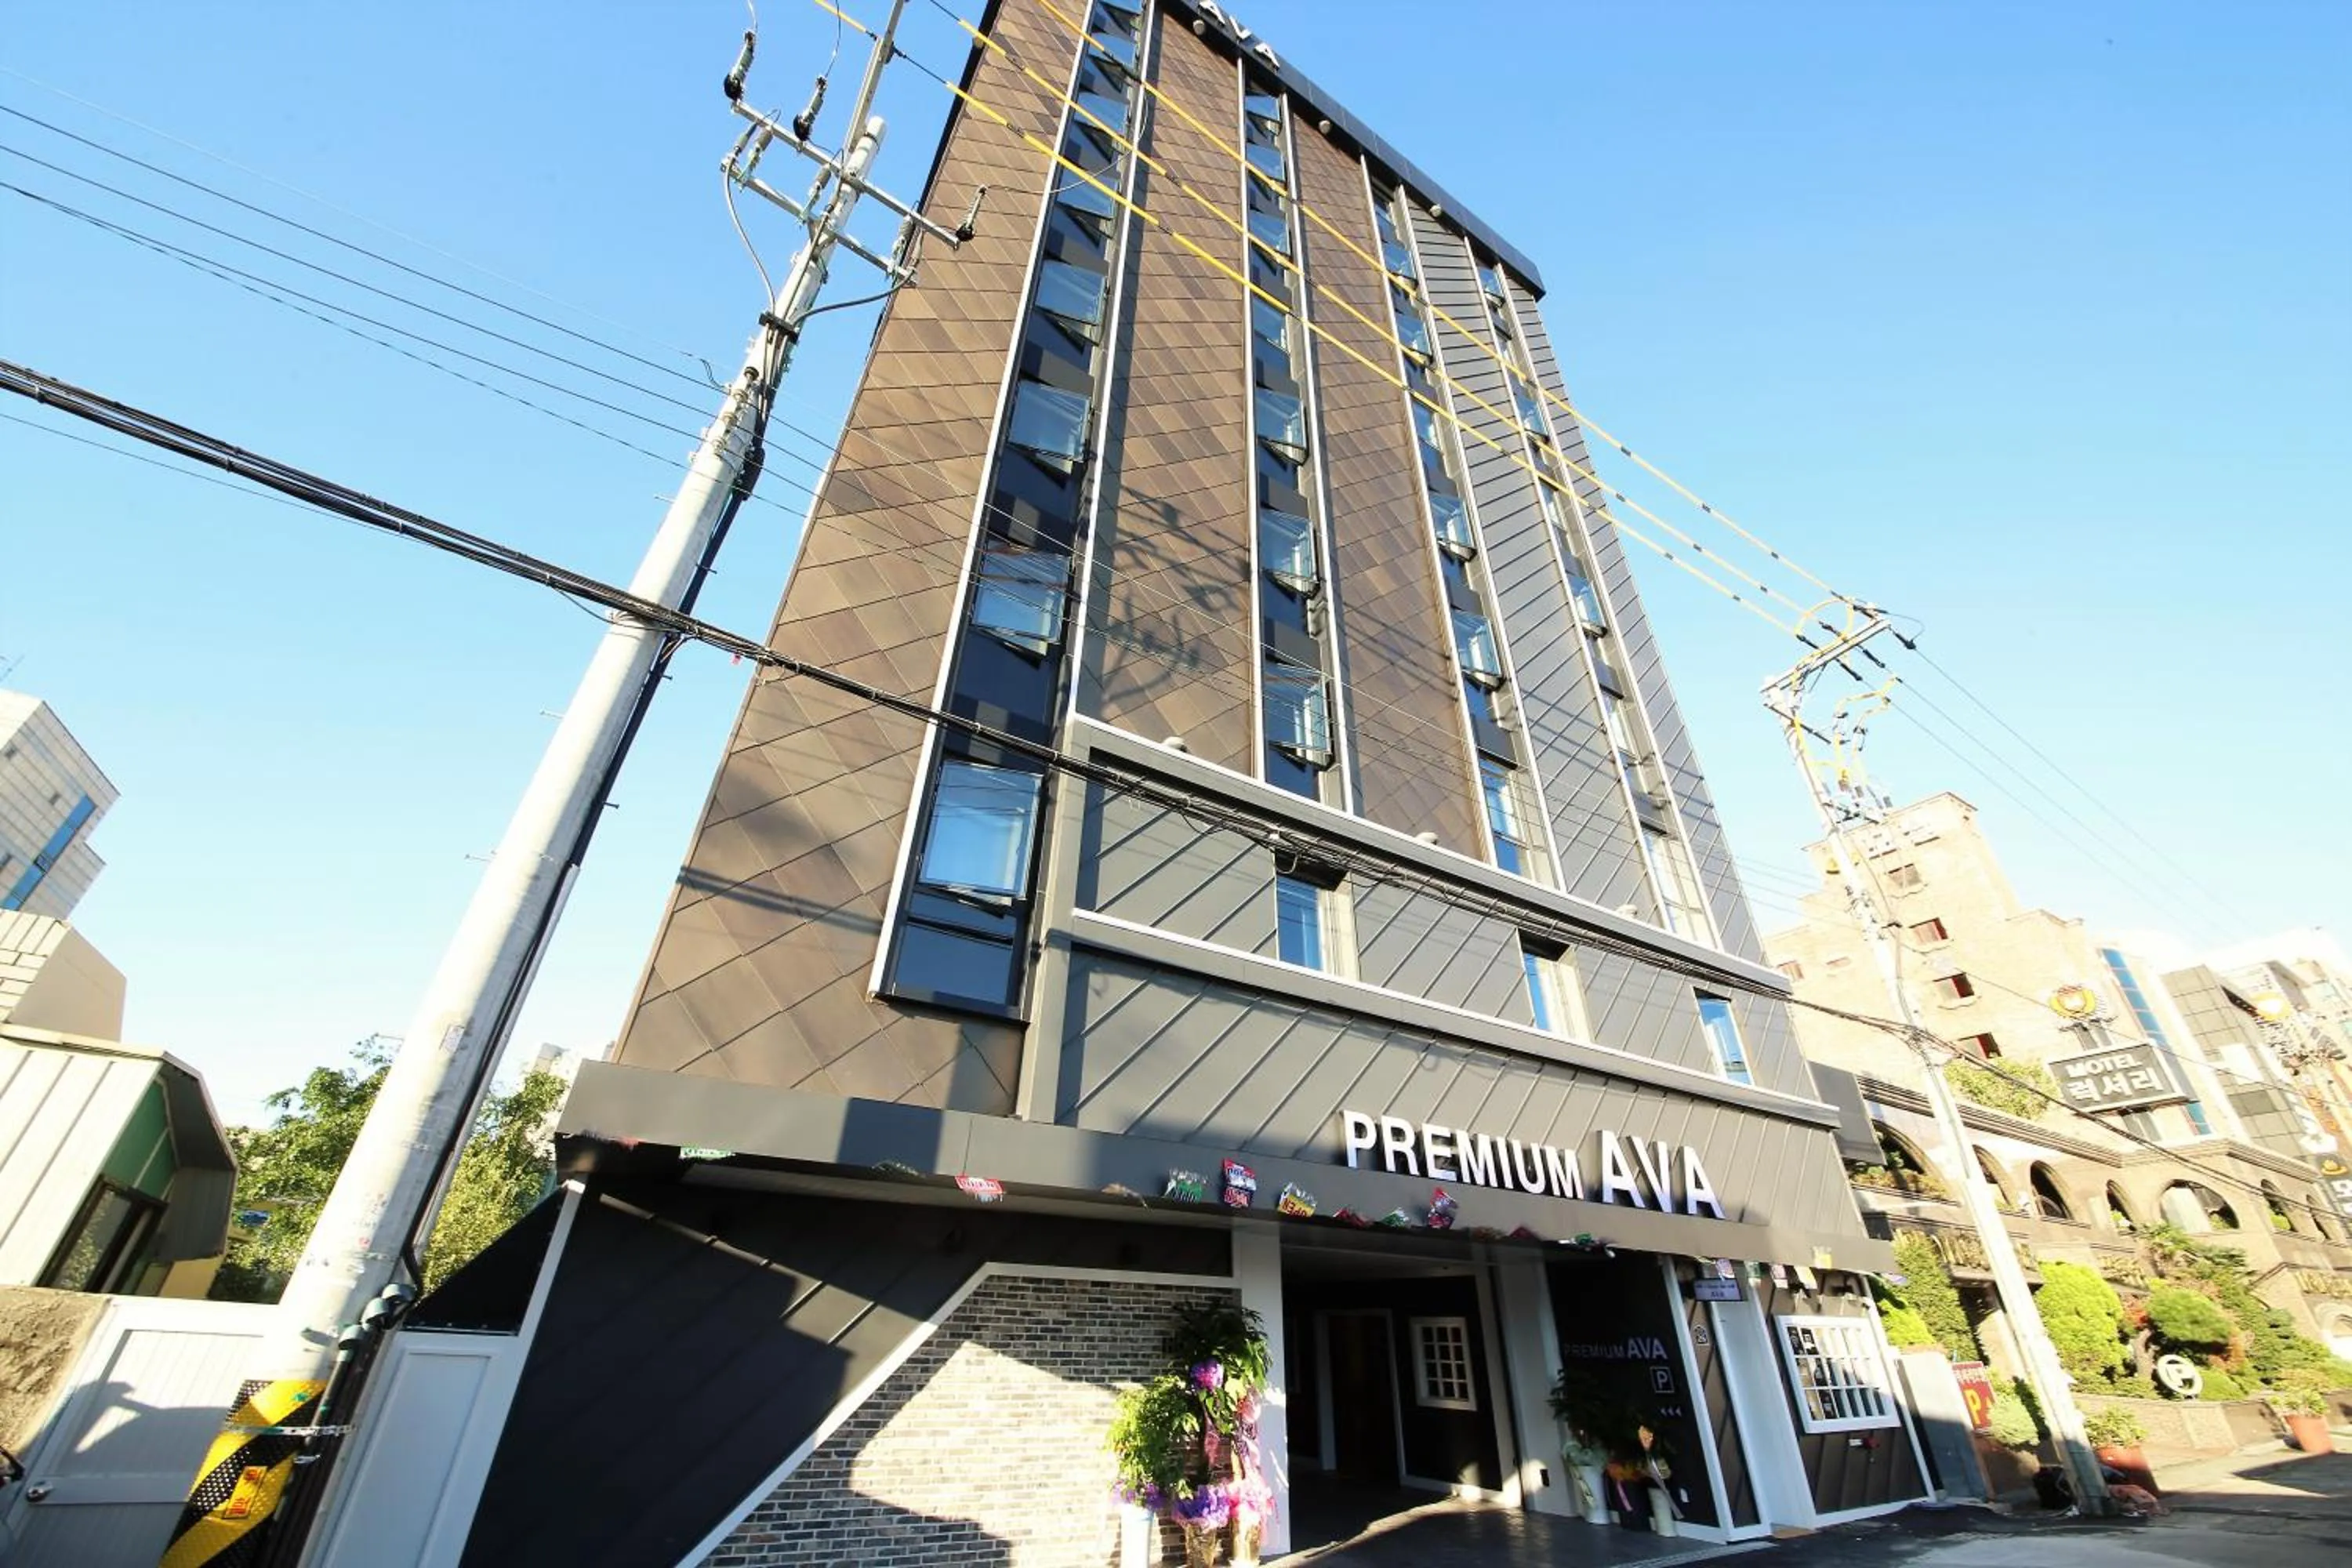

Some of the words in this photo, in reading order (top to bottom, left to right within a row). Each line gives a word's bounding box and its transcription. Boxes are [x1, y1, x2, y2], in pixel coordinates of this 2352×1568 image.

[1199, 0, 1279, 68] AVA
[2065, 1053, 2143, 1078] MOTEL
[1341, 1109, 1585, 1200] PREMIUM
[1597, 1129, 1726, 1220] AVA
[1627, 1338, 1668, 1359] AVA
[1657, 1370, 1668, 1390] P
[1963, 1388, 1982, 1425] P
